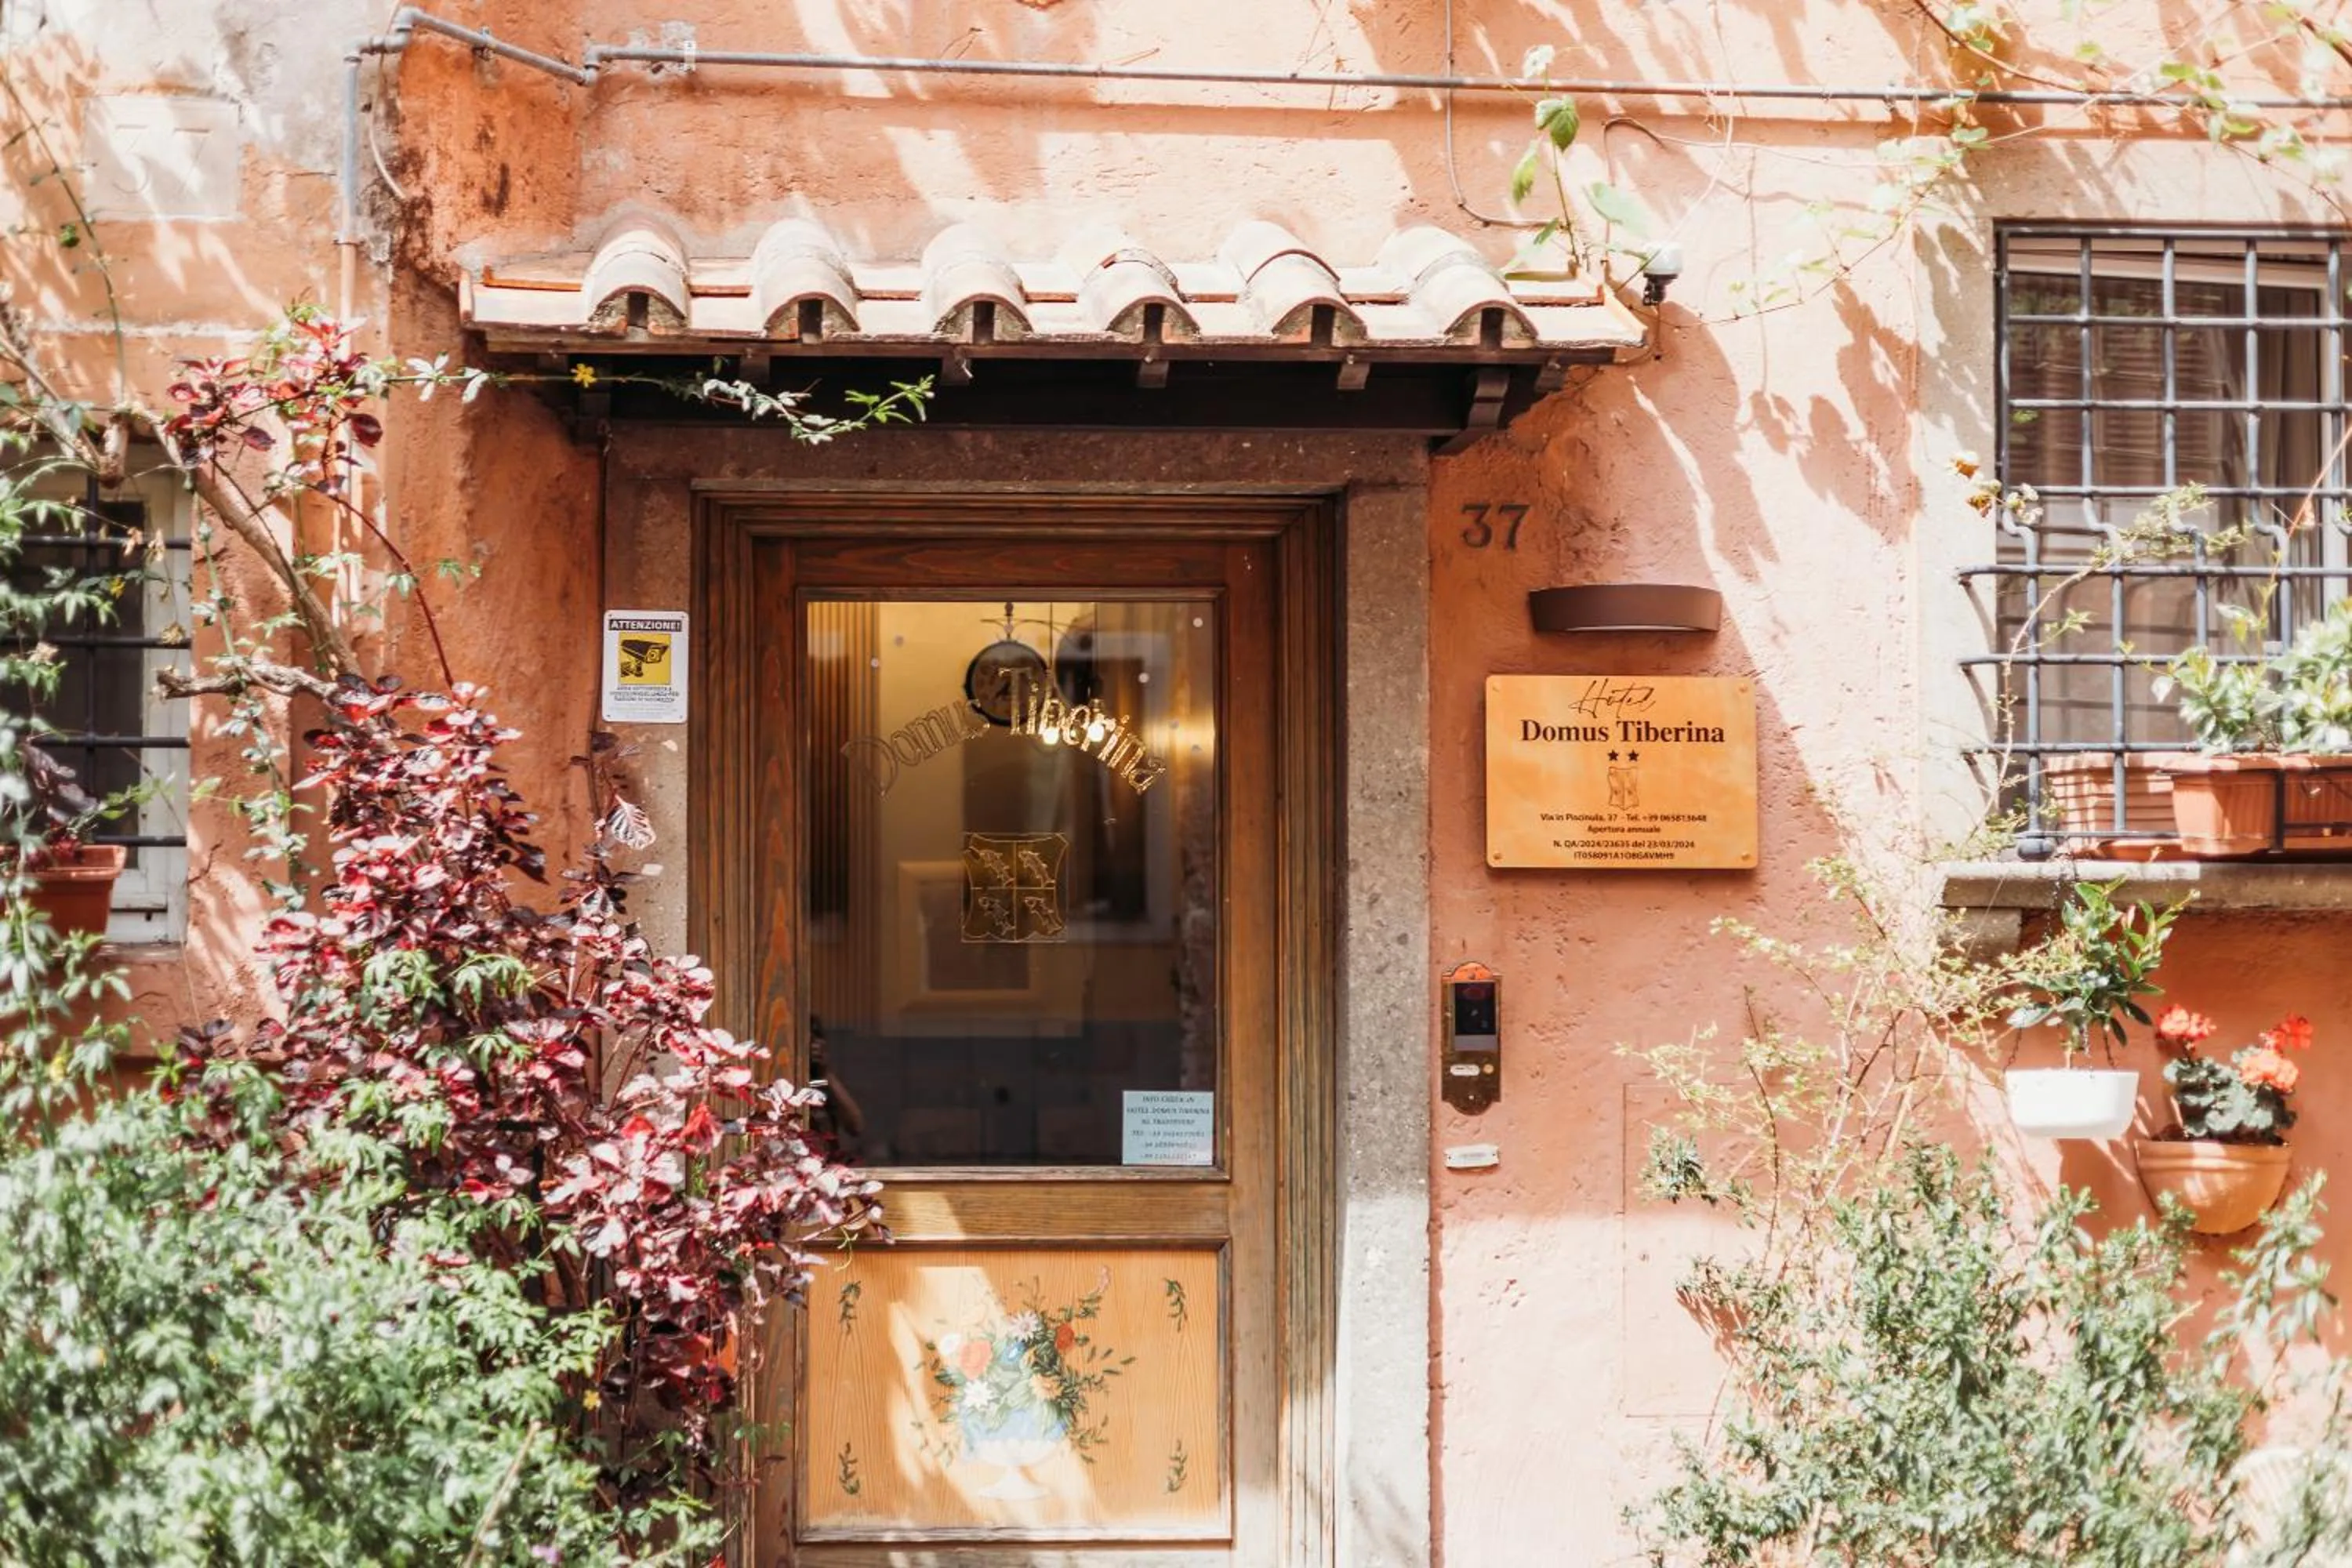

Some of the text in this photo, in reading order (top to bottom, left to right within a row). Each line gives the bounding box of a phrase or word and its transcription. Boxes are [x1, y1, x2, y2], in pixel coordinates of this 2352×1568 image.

[111, 124, 212, 197] 37
[1461, 503, 1530, 551] 37
[610, 619, 681, 630] ATTENZIONE!
[839, 666, 1167, 802] Domus Tiberina
[1520, 719, 1726, 743] Domus Tiberina
[1588, 824, 1661, 834] Apertura annuale
